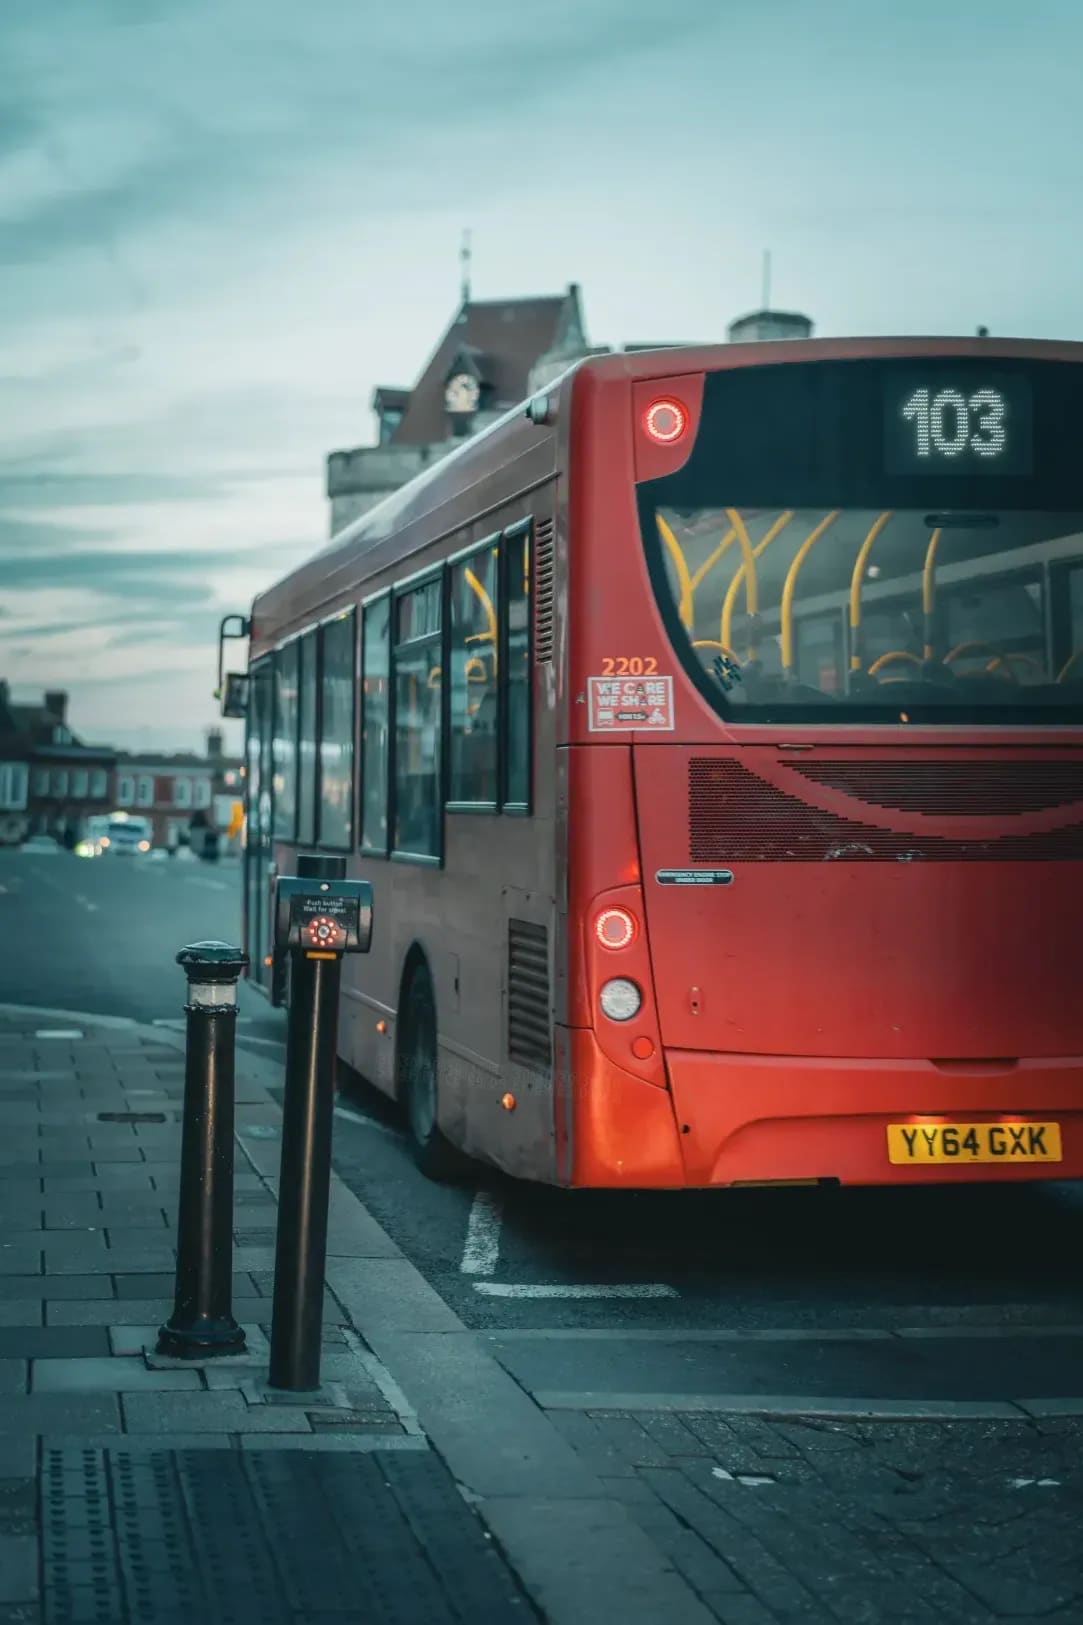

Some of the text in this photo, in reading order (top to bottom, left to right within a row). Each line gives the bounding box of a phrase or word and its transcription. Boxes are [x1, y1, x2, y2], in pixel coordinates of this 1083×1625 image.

[902, 388, 1006, 456] 103
[602, 656, 659, 677] 2202
[596, 682, 620, 695] WE
[597, 694, 619, 706] WE
[323, 899, 344, 907] button
[901, 1126, 1048, 1157] YY64 GXK
